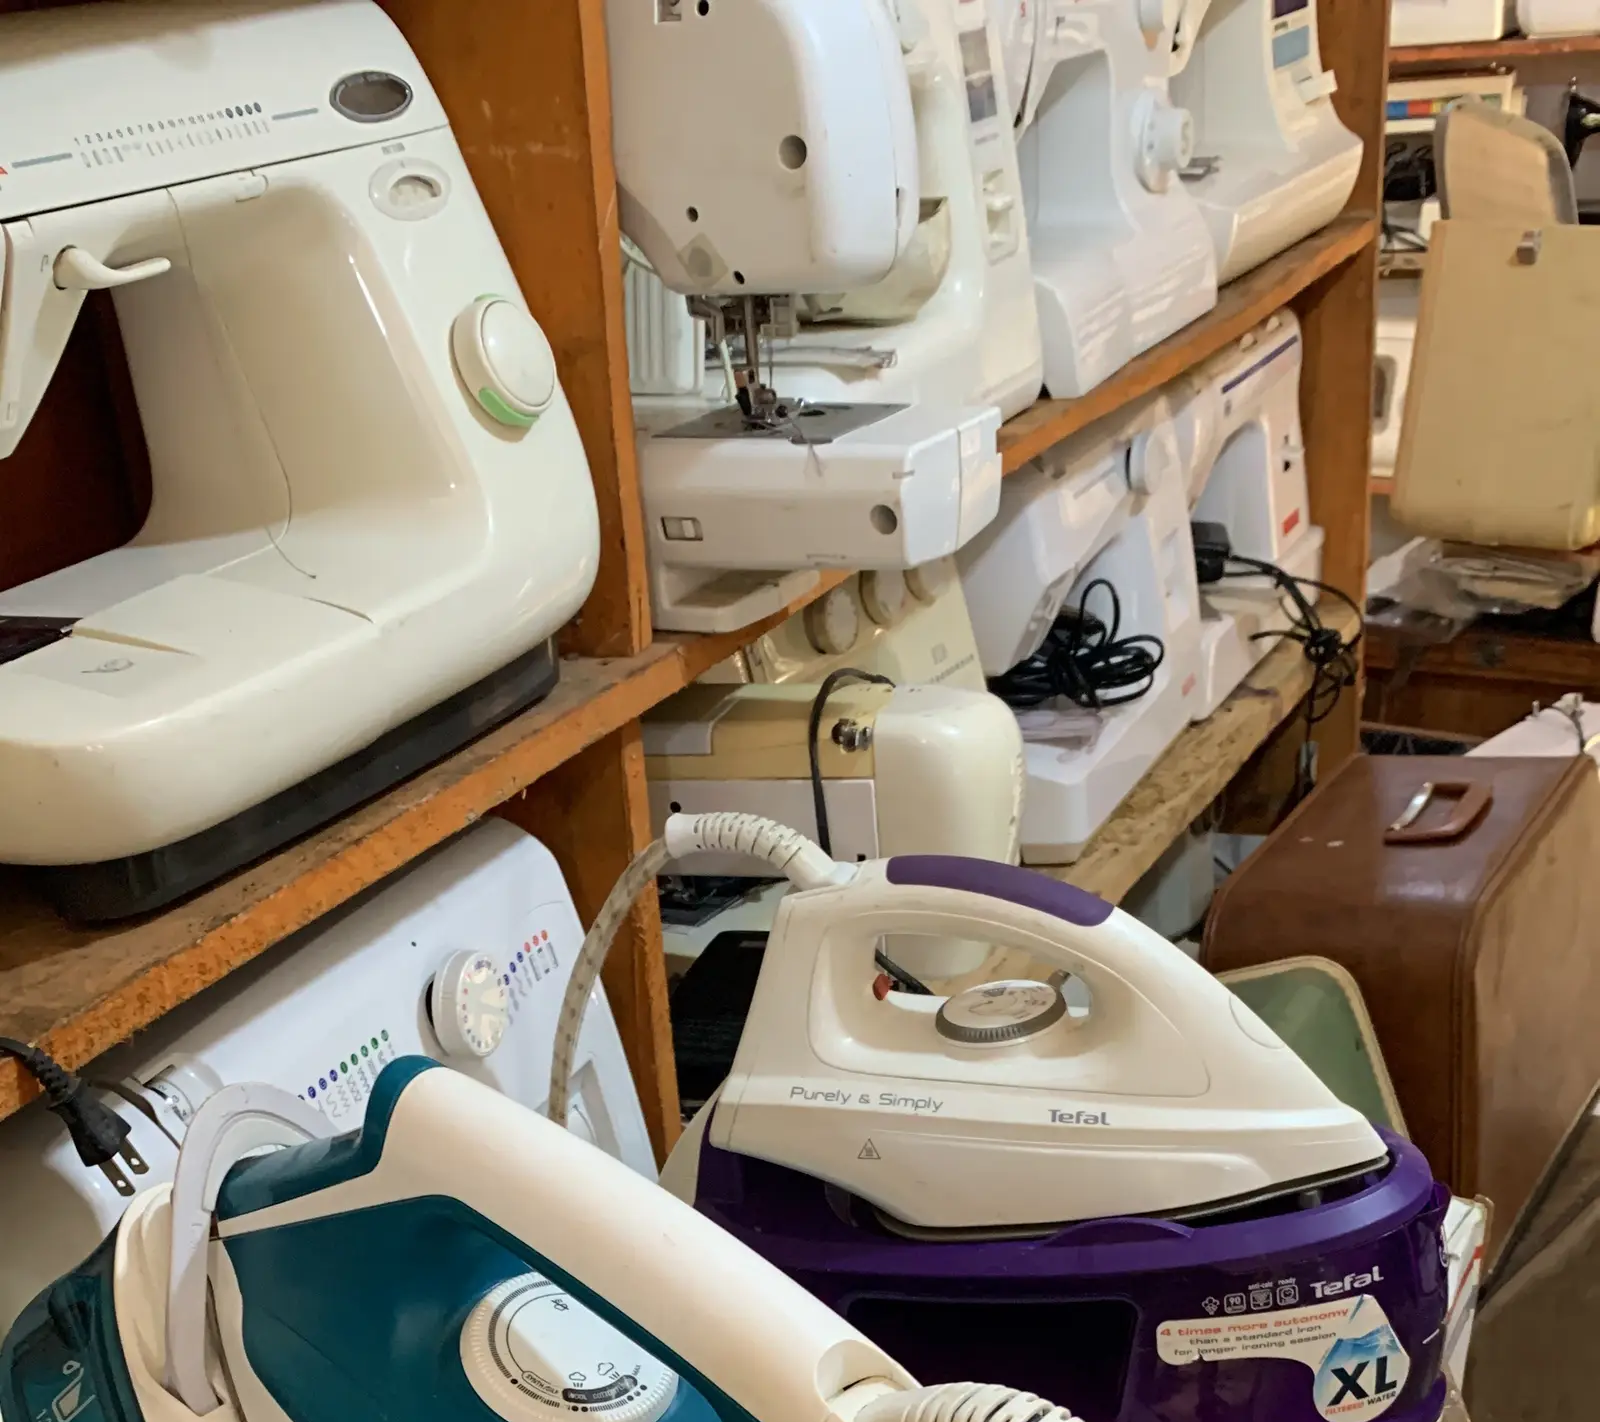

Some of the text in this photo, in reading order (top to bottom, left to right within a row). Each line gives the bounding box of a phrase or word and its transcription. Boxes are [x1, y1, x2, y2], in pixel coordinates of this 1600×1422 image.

[789, 1086, 944, 1113] Purely & Simply
[1047, 1108, 1111, 1126] Tefal
[1310, 1265, 1384, 1299] Tefal
[1160, 1308, 1349, 1337] 4 times more autonomy
[1189, 1335, 1218, 1346] than
[1235, 1328, 1293, 1342] standard
[1297, 1324, 1322, 1334] iron
[1173, 1331, 1337, 1357] for longer ironing session
[1326, 1355, 1397, 1407] XL
[1367, 1390, 1397, 1406] WATER
